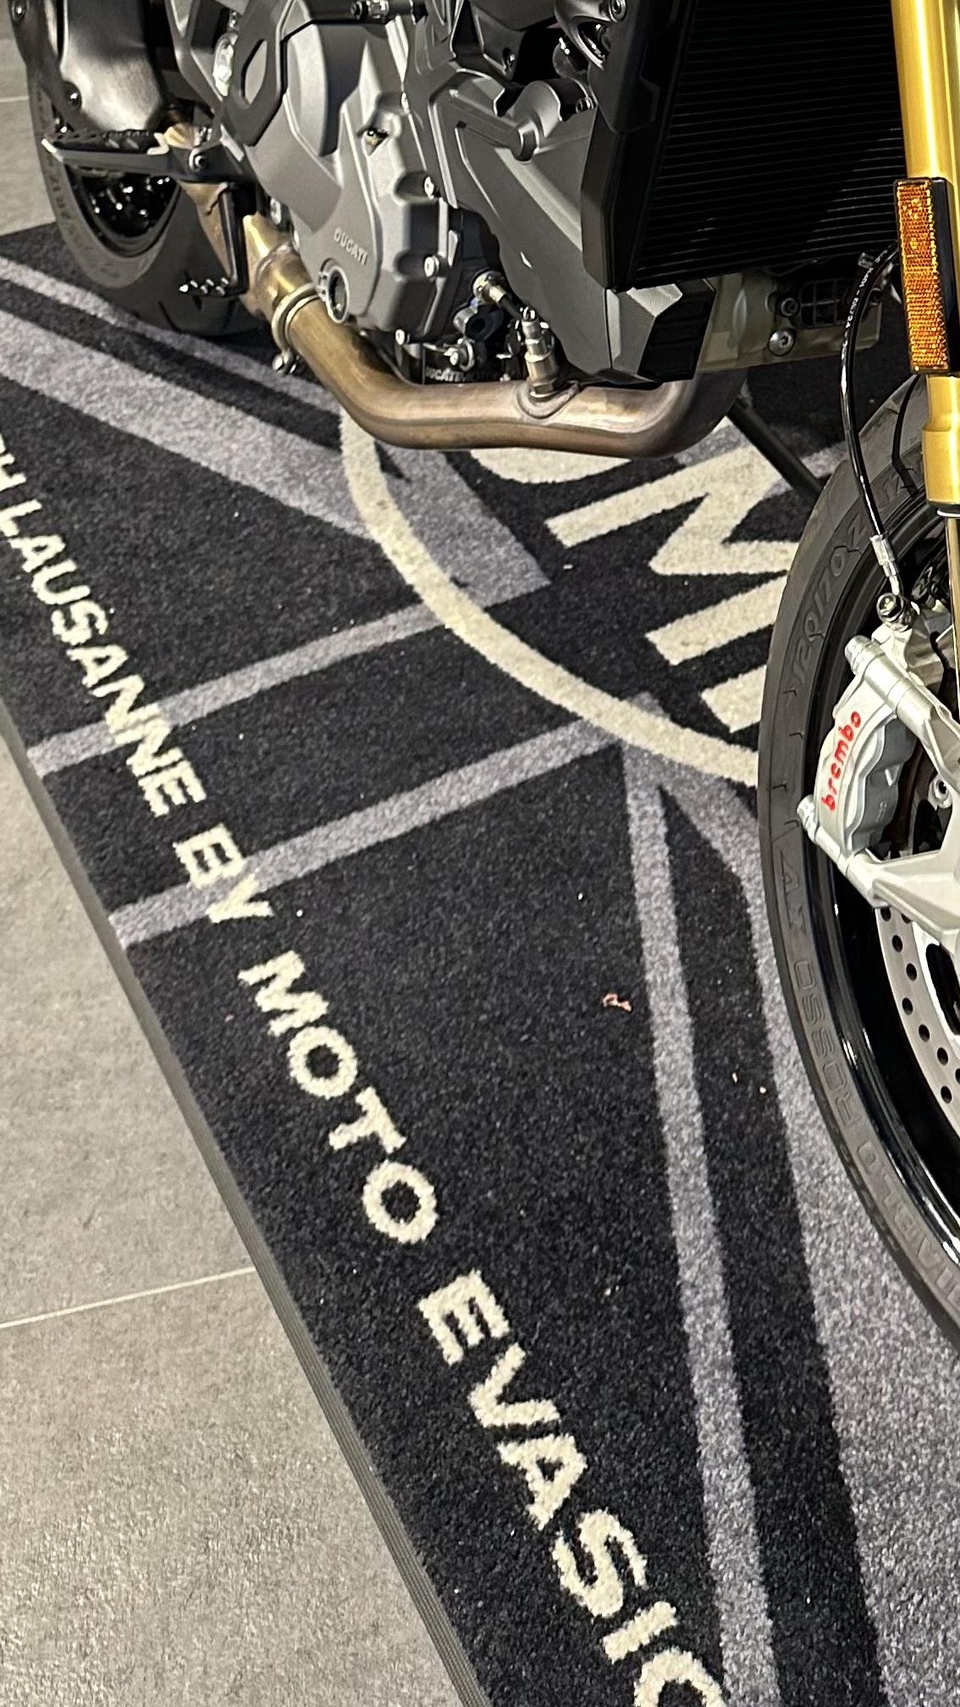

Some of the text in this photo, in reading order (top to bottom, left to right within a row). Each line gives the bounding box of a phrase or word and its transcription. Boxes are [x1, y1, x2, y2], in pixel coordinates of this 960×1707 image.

[333, 227, 368, 266] DUCATI
[821, 710, 862, 813] brembo
[0, 499, 207, 817] LAUSANNE
[173, 822, 274, 924] BY
[237, 950, 439, 1244] MOTO
[793, 960, 858, 1128] ROSSO
